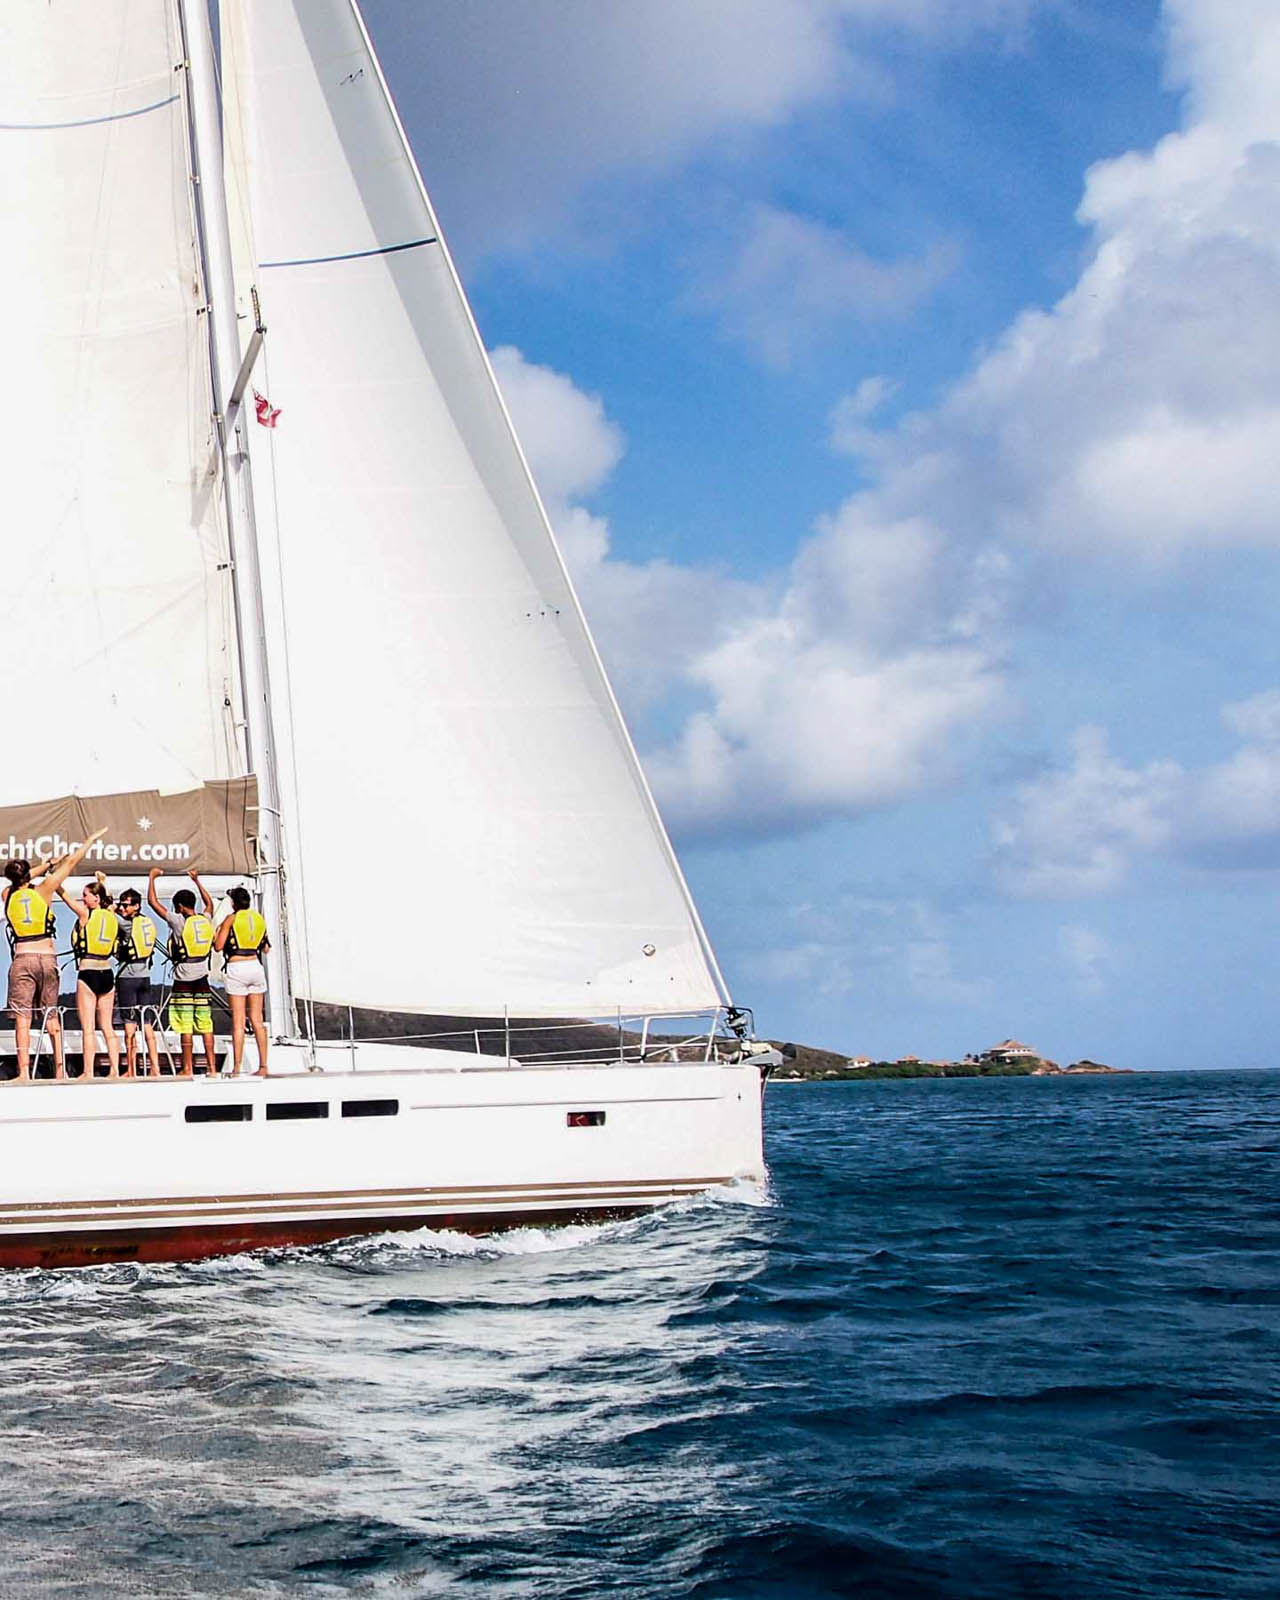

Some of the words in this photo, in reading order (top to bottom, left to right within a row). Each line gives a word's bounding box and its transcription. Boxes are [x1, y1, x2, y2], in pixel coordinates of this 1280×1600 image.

[17, 898, 32, 924] I
[98, 917, 112, 945] L
[141, 922, 153, 947] E
[191, 920, 208, 945] E
